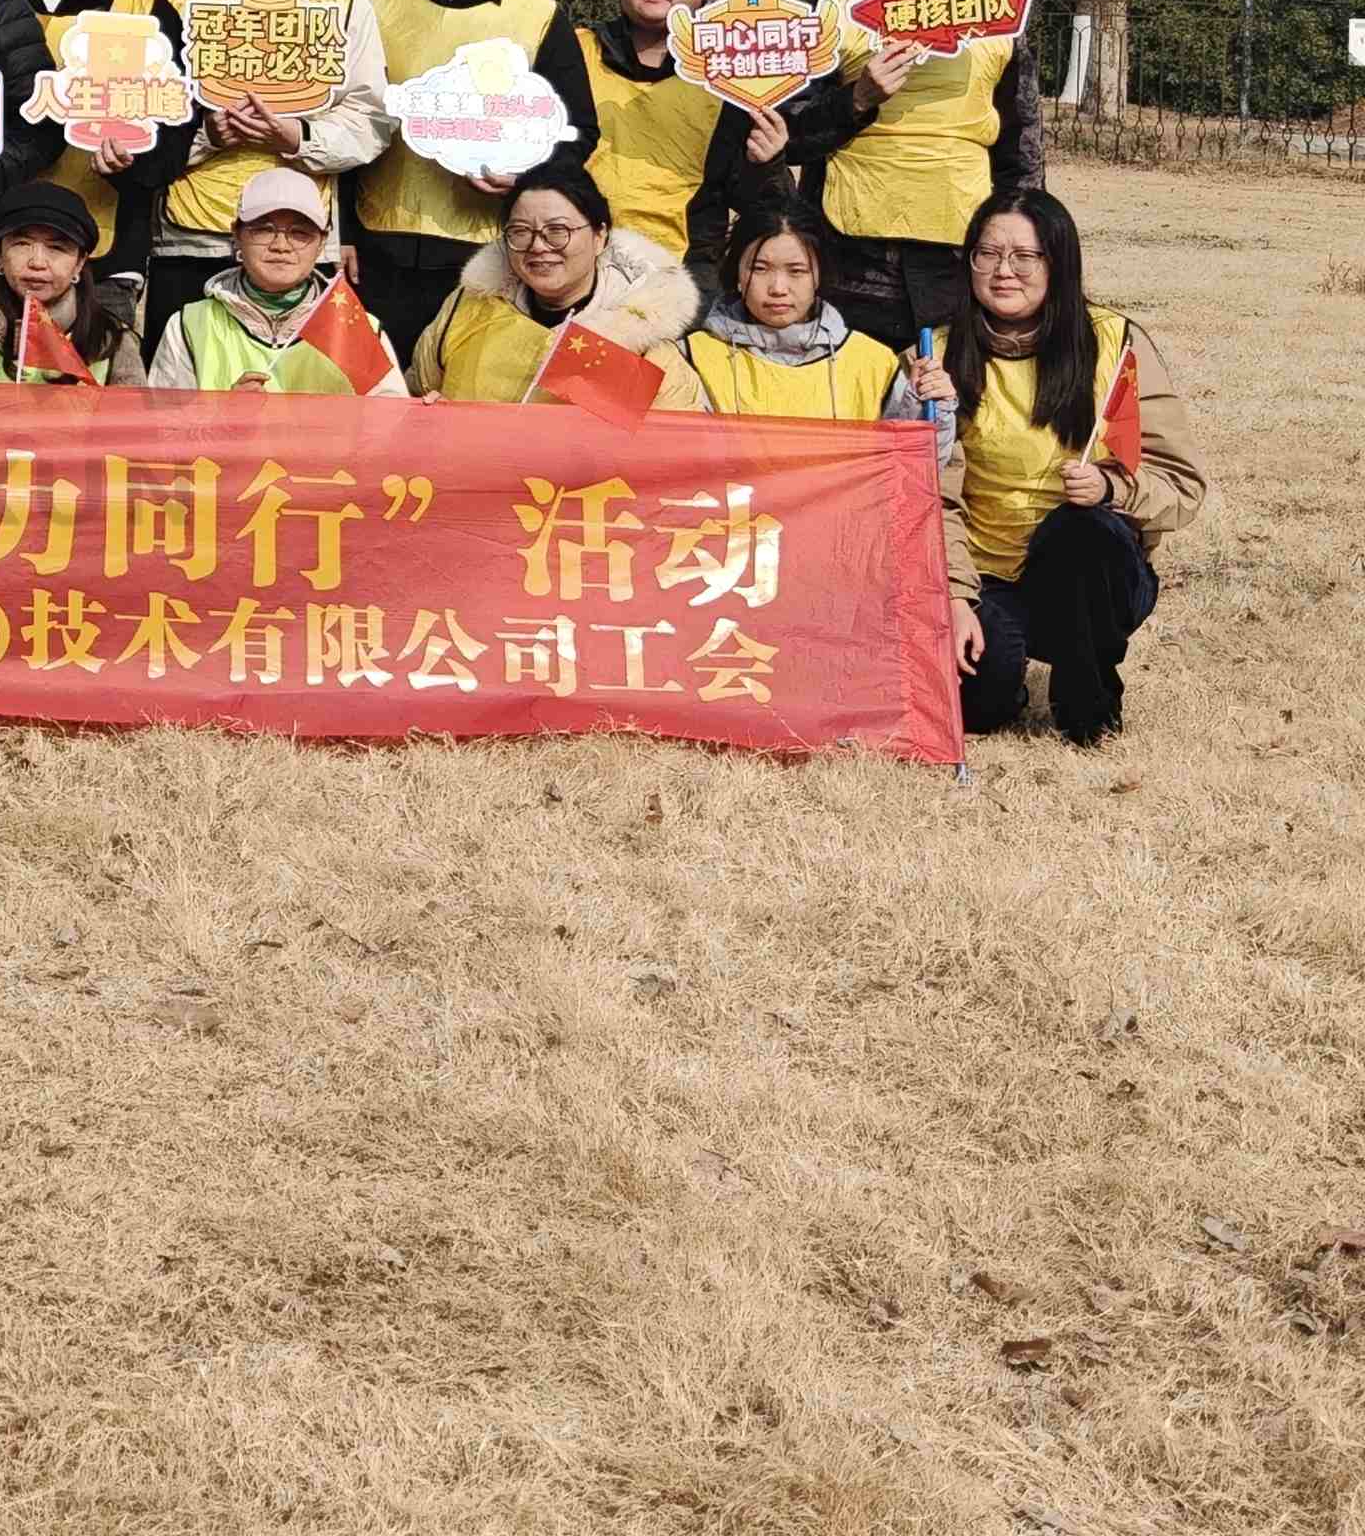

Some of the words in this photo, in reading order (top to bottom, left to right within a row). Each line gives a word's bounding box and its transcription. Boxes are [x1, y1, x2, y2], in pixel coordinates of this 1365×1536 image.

[189, 3, 347, 47] 冠军团队
[692, 15, 822, 54] 同心同行
[188, 40, 346, 84] 使命必达
[705, 51, 811, 79] 共创佳绩
[25, 76, 188, 119] 人生巅峰
[510, 474, 784, 609] 活动
